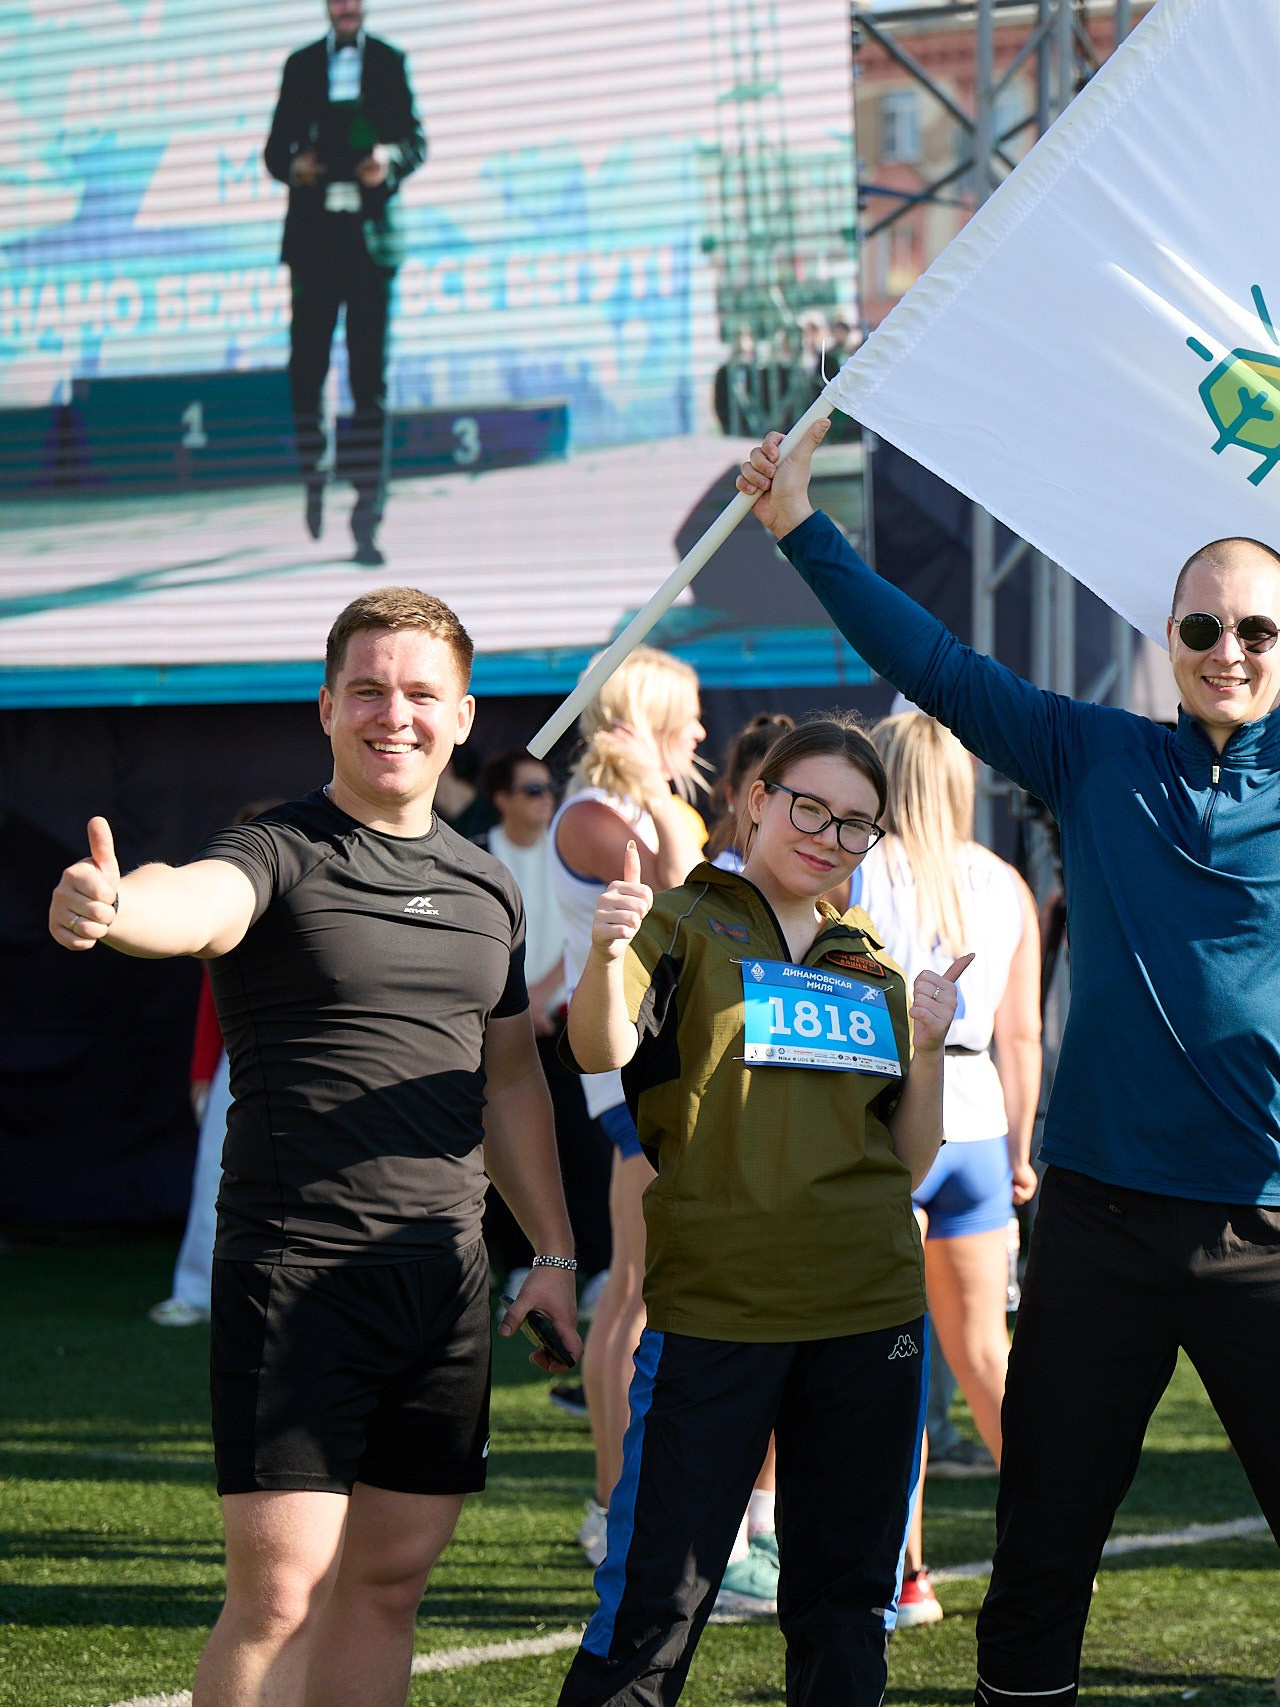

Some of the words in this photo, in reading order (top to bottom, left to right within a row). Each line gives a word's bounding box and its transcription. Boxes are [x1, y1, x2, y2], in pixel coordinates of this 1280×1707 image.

[181, 400, 208, 449] 1
[453, 417, 480, 464] 3
[782, 967, 852, 990] ДИНАМОВСКАЯ
[806, 980, 833, 993] МИЛЯ
[768, 996, 876, 1046] 1818
